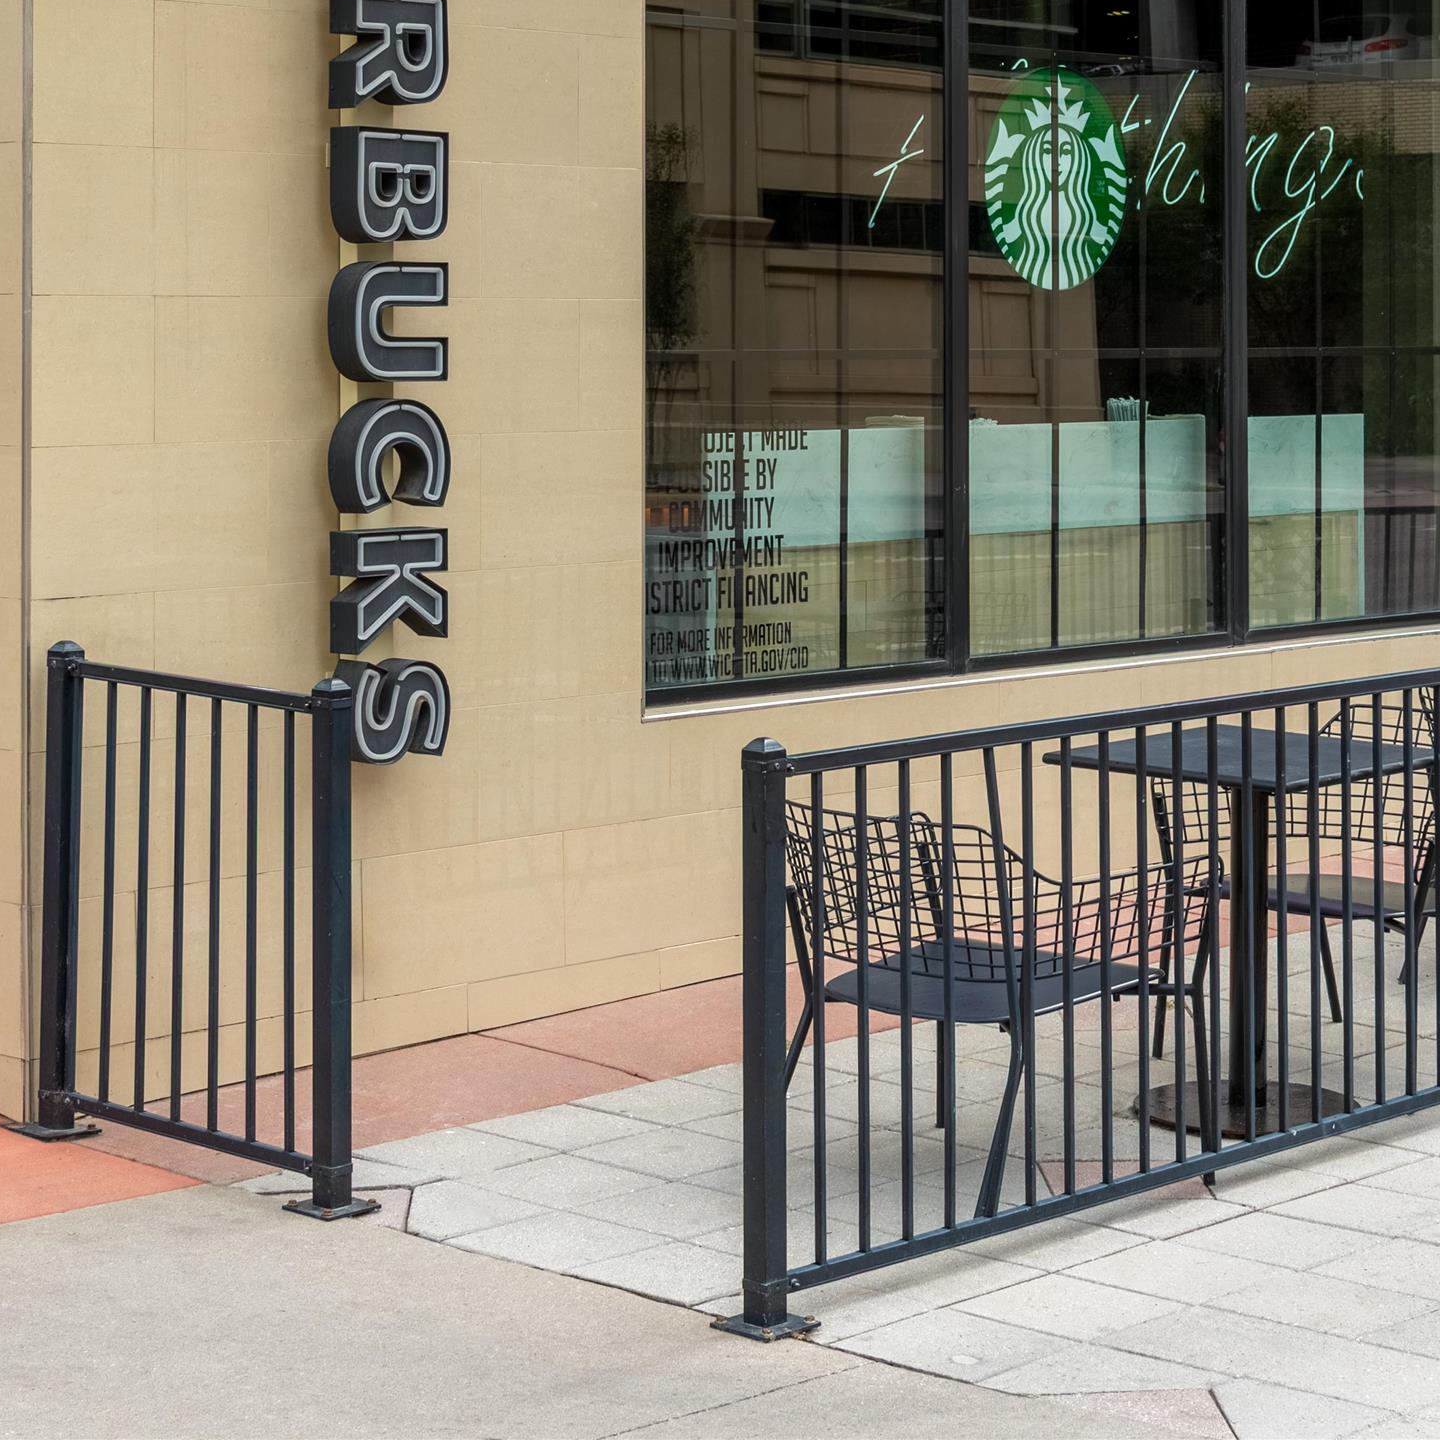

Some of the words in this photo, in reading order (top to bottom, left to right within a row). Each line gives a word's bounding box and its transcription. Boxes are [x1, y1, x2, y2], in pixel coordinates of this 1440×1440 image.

[761, 421, 809, 452] MADE
[756, 458, 778, 491] BY
[658, 534, 785, 574] IMPROVEMENT
[646, 578, 712, 615] ISTRICT
[650, 631, 674, 655] FOR
[677, 628, 711, 653] MORE
[670, 646, 809, 682] WWW.WICTA.GOV/CID
